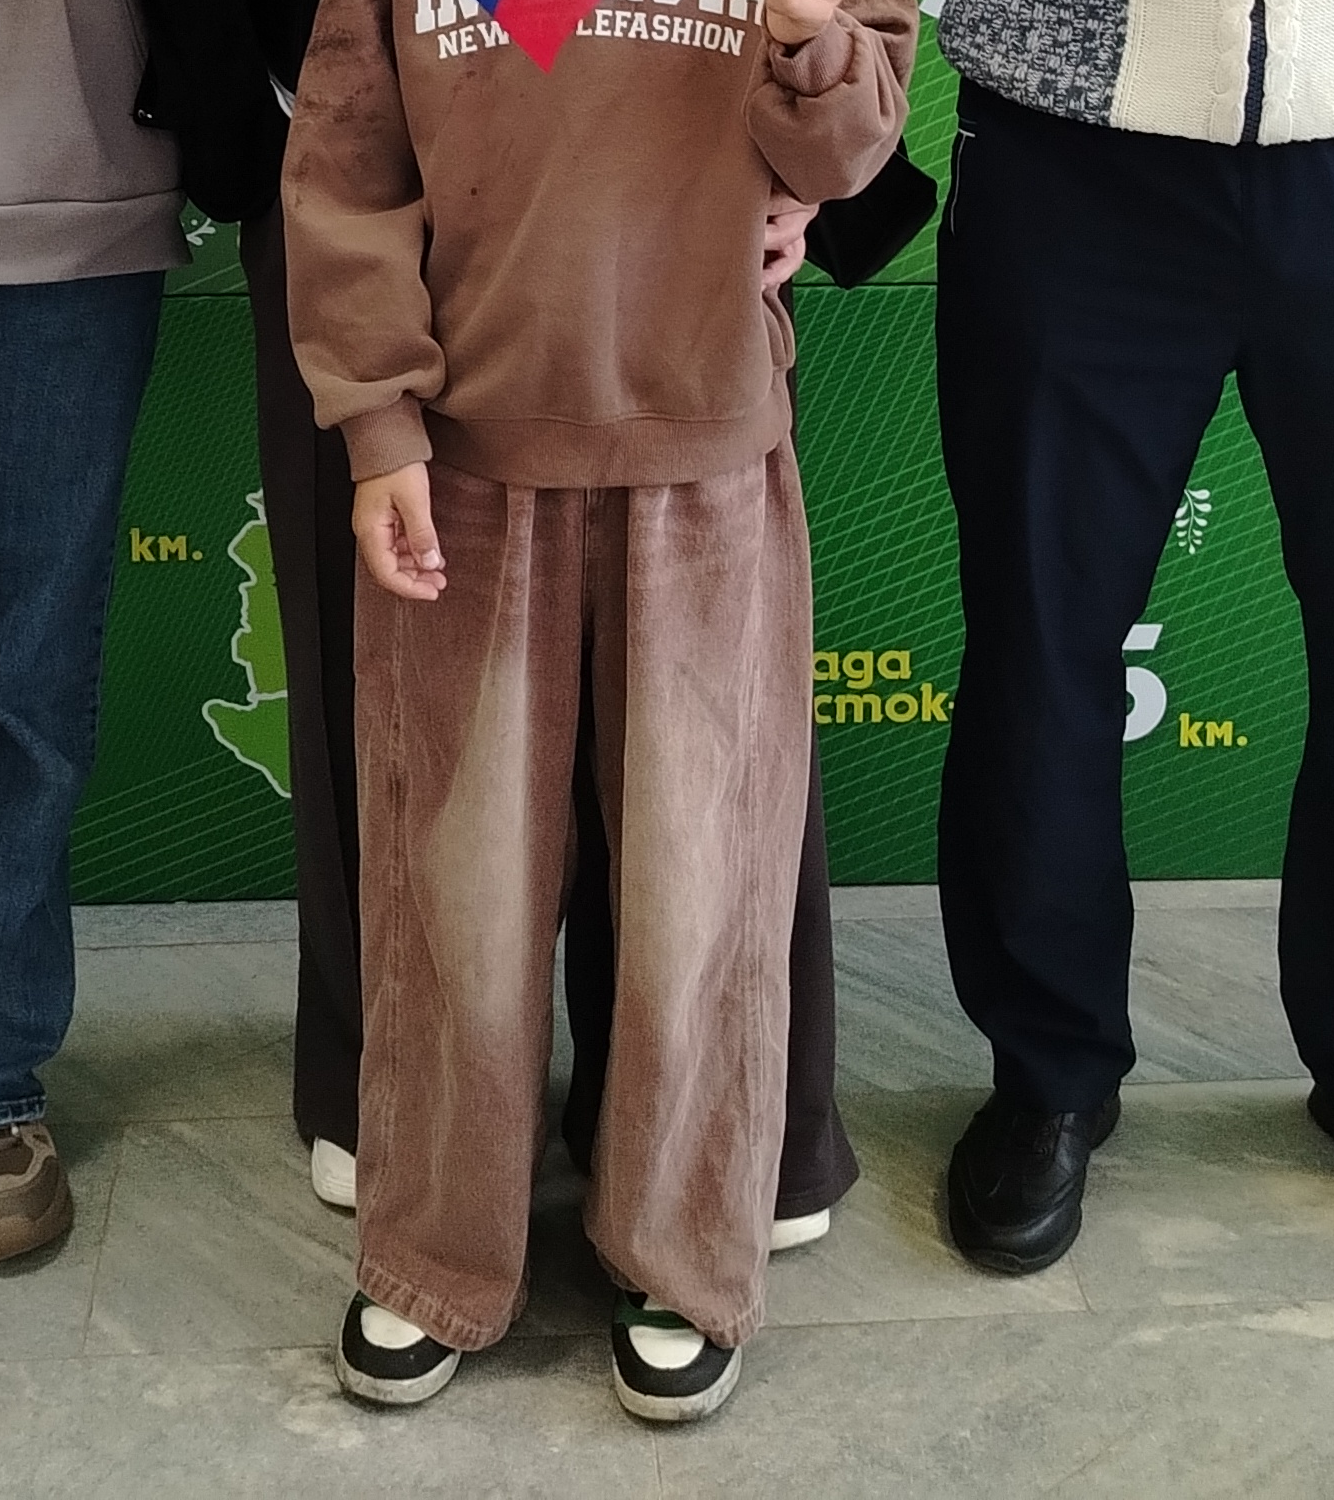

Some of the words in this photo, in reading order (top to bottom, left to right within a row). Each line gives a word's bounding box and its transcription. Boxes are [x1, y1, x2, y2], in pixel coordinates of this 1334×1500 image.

[130, 527, 203, 562] км.
[812, 683, 950, 724] сток
[1178, 712, 1249, 748] км.
